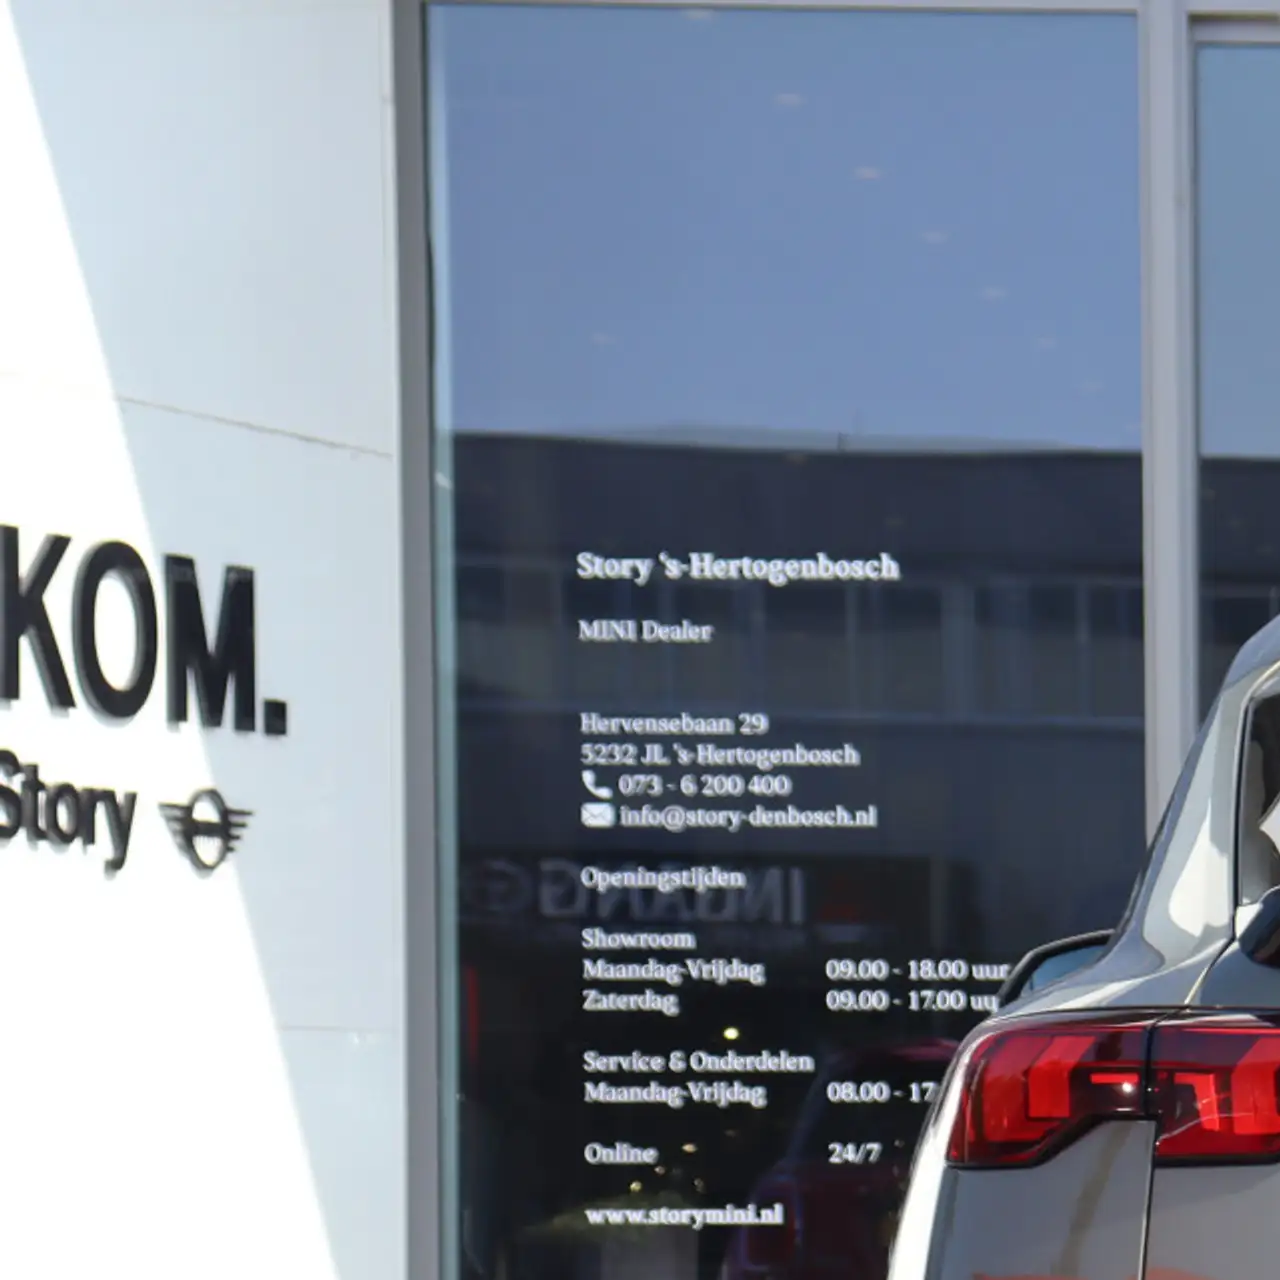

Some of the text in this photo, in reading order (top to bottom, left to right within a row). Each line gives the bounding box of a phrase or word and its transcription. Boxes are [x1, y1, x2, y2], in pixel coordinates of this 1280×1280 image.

[576, 551, 654, 585] Story
[0, 524, 288, 736] KOM.
[578, 619, 713, 643] MINI Dealer
[580, 711, 769, 735] Hervensebaan 29
[581, 743, 638, 766] 5232
[640, 743, 671, 765] JL
[618, 774, 663, 796] 073
[679, 774, 698, 796] 6
[700, 774, 745, 797] 200
[747, 774, 792, 796] 400
[620, 804, 878, 831] info@story-denbosch.nl
[579, 866, 747, 894] Openingstijden
[581, 927, 697, 949] Showroom
[583, 958, 766, 986] Maandag-Vrijdag
[825, 959, 890, 980] 09.00
[908, 959, 969, 981] 18.00
[971, 963, 1013, 982] uur
[582, 989, 680, 1017] Zaterdag
[825, 989, 890, 1011] 09.00
[908, 989, 967, 1011] 17.00
[971, 994, 998, 1012] uu
[583, 1050, 815, 1073] Service & Onderdelen
[584, 1080, 768, 1108] Maandag-Vrijdag
[826, 1081, 891, 1103] 08.00
[583, 1142, 658, 1164] Online
[828, 1142, 882, 1164] 24/7
[584, 1203, 784, 1230] www.storymini.nl
